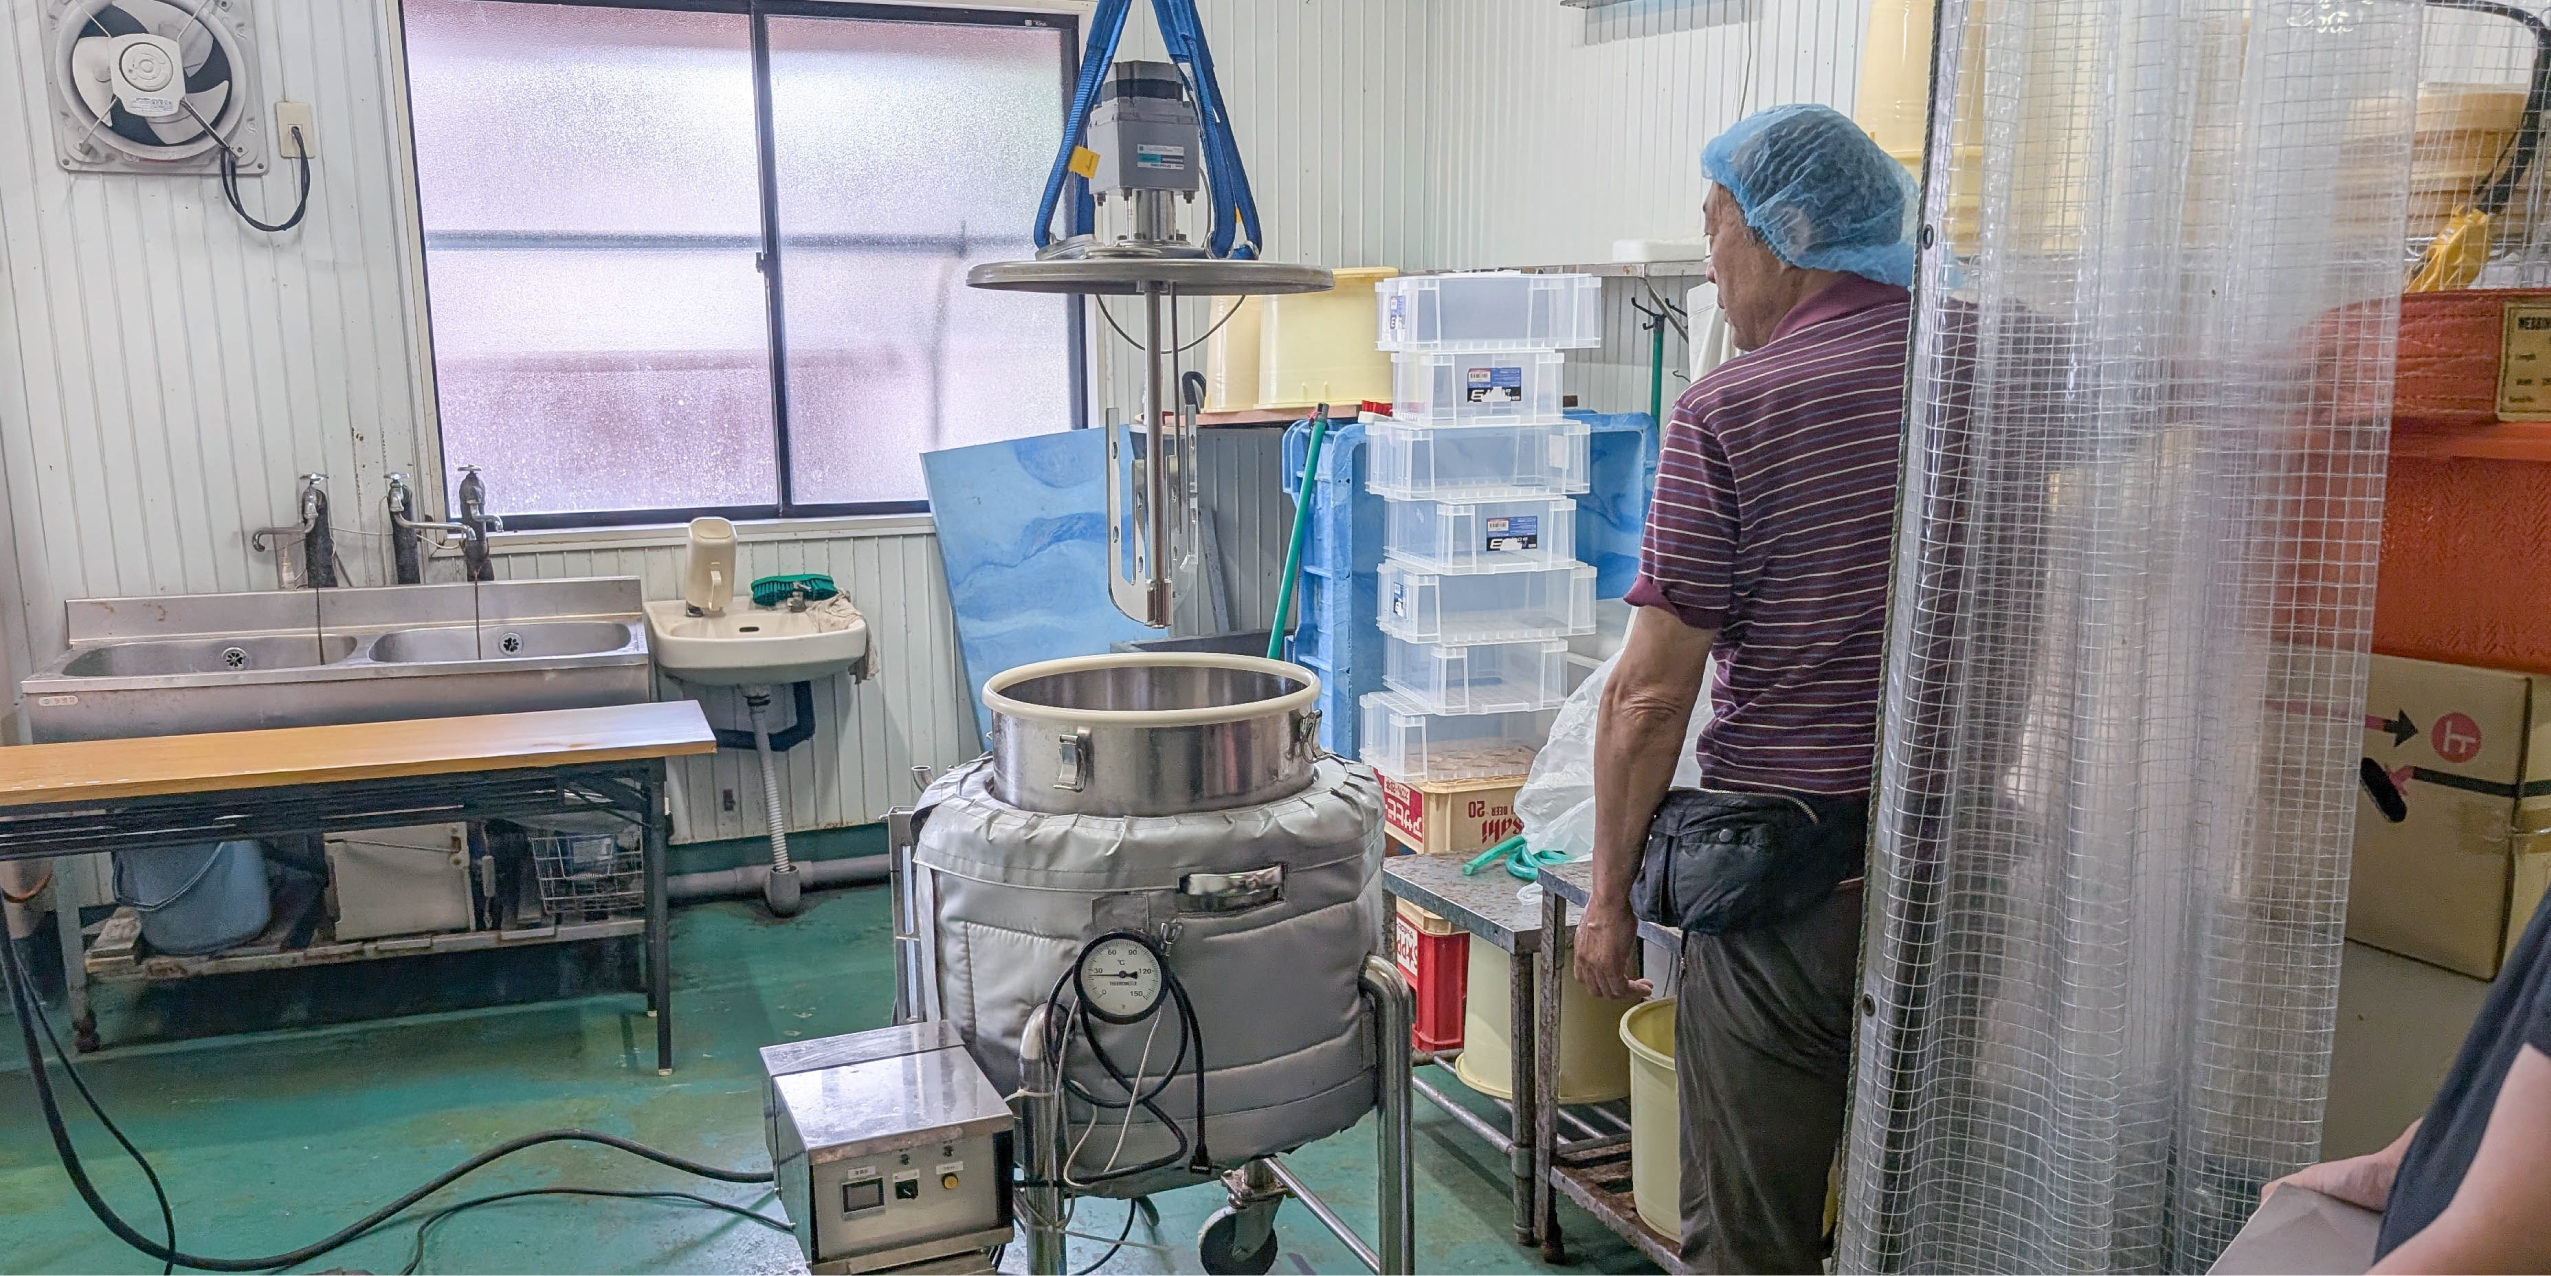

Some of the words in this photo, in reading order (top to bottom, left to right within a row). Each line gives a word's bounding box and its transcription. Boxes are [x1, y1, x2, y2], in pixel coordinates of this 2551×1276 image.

[2443, 720, 2476, 753] 上
[1468, 800, 1485, 819] 20
[1491, 805, 1508, 817] BEER
[1482, 817, 1524, 845] sahi
